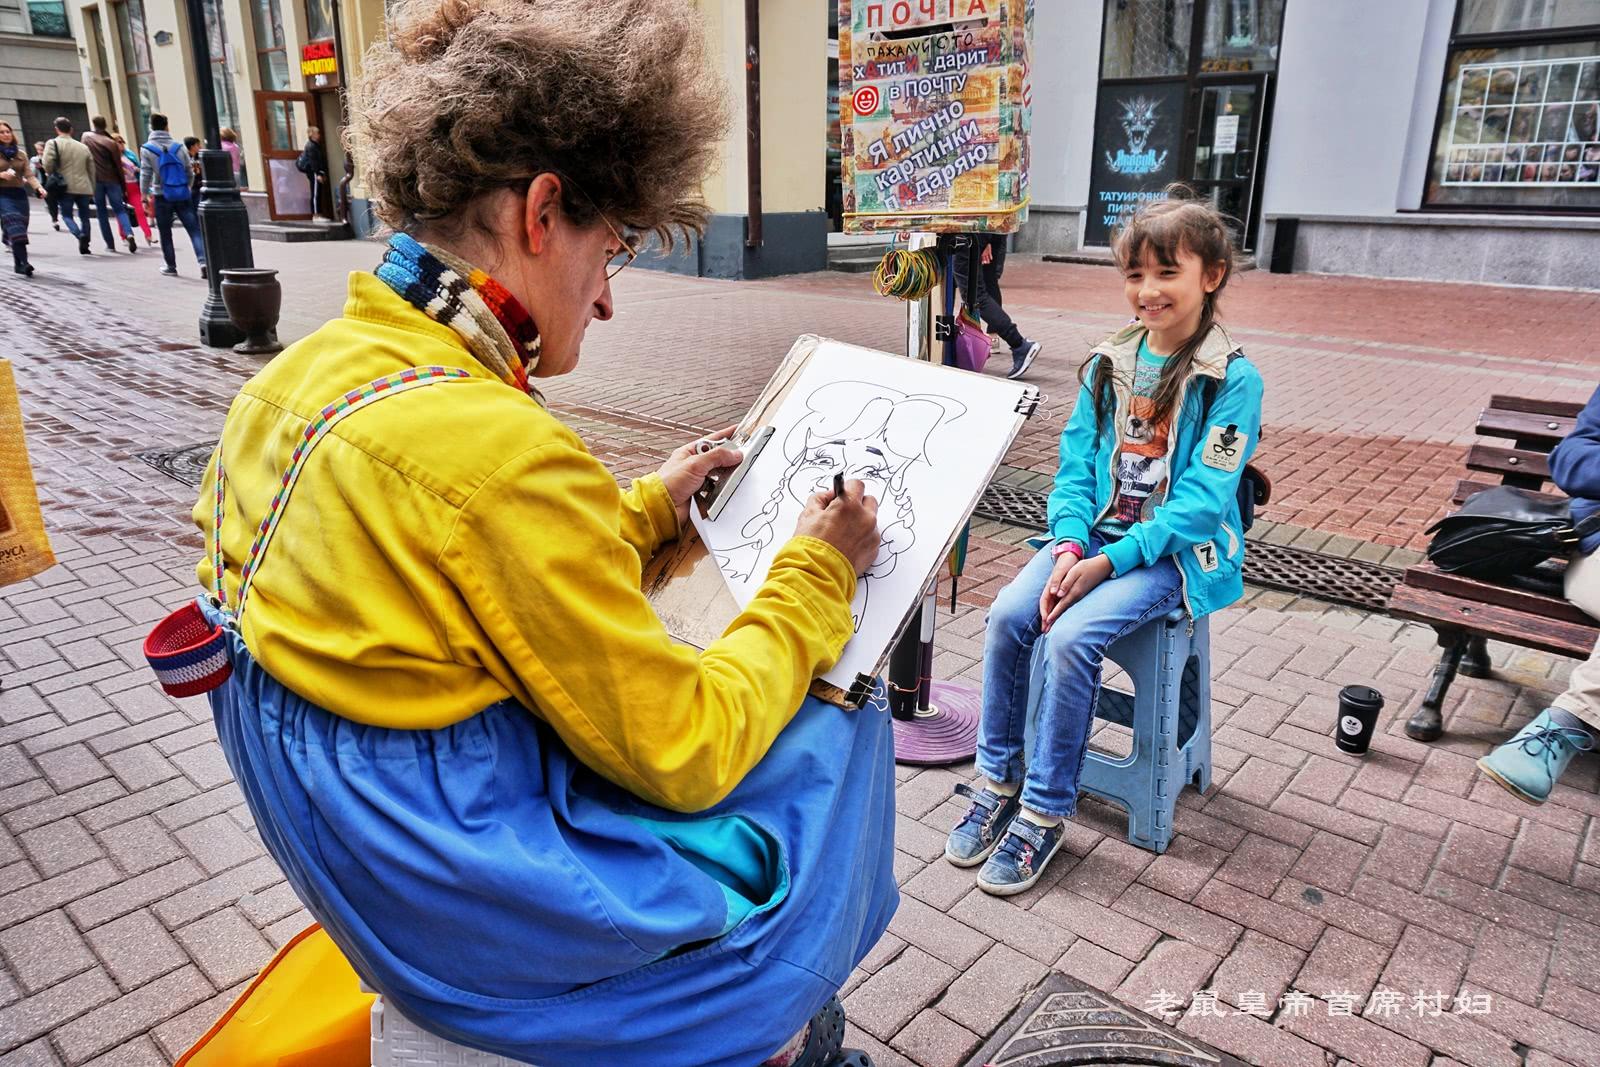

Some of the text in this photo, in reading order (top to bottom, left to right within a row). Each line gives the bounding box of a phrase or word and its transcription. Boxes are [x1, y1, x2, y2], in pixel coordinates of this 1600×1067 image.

[867, 0, 987, 28] ПОЧТА
[906, 74, 967, 97] ПОЧТУ
[868, 100, 964, 166] Я лично
[876, 120, 979, 191] картинки
[1099, 191, 1169, 202] ТАТУИРОВКИ
